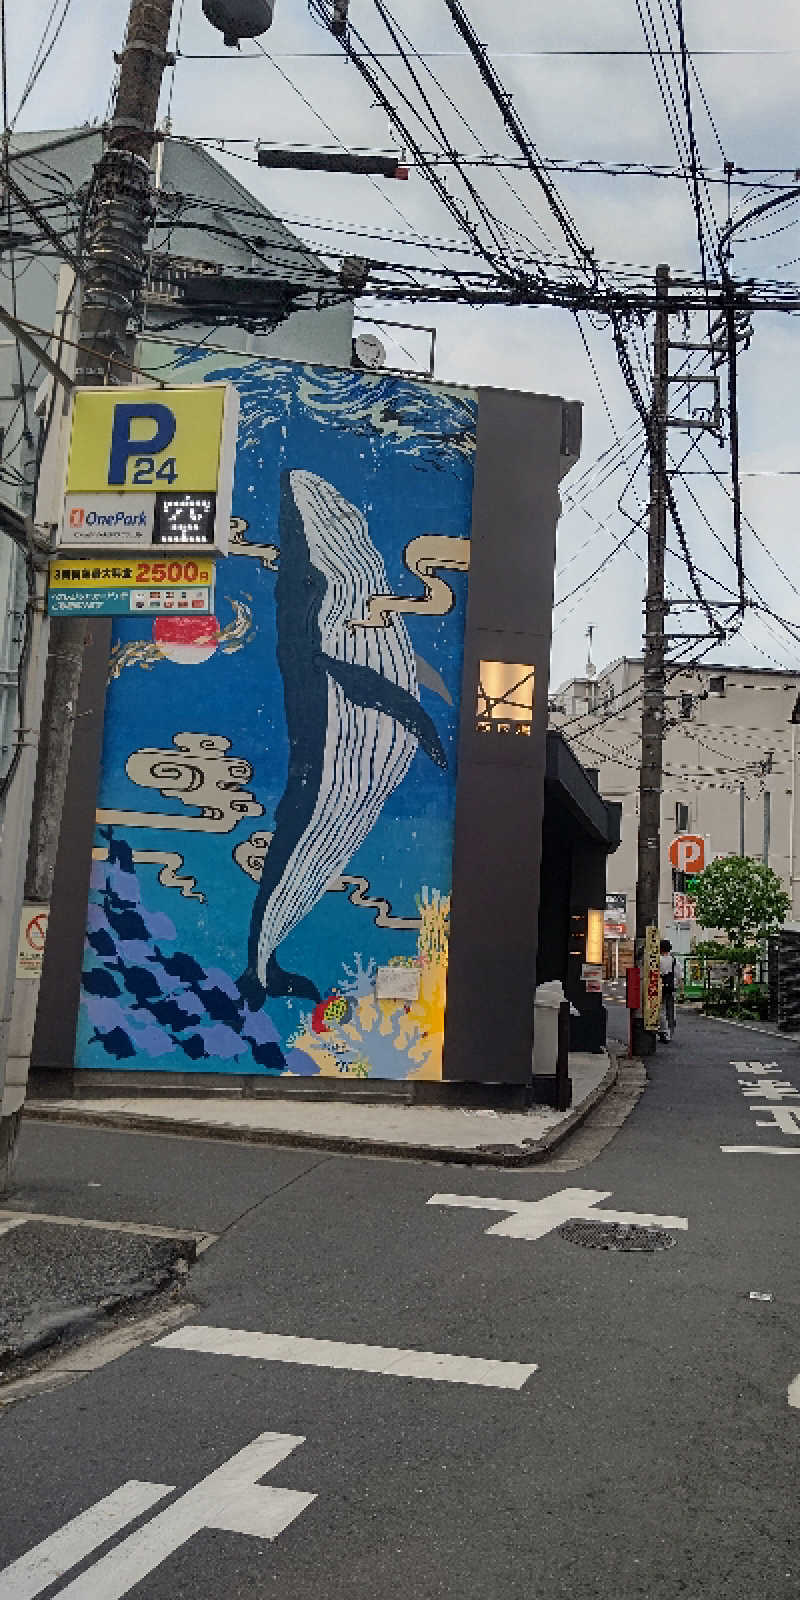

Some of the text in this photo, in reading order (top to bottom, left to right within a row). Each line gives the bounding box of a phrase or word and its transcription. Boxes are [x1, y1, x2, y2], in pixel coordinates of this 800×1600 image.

[108, 404, 177, 485] P
[132, 457, 178, 484] 24
[86, 510, 147, 527] OnePark
[161, 495, 210, 542] 空
[678, 841, 701, 873] P
